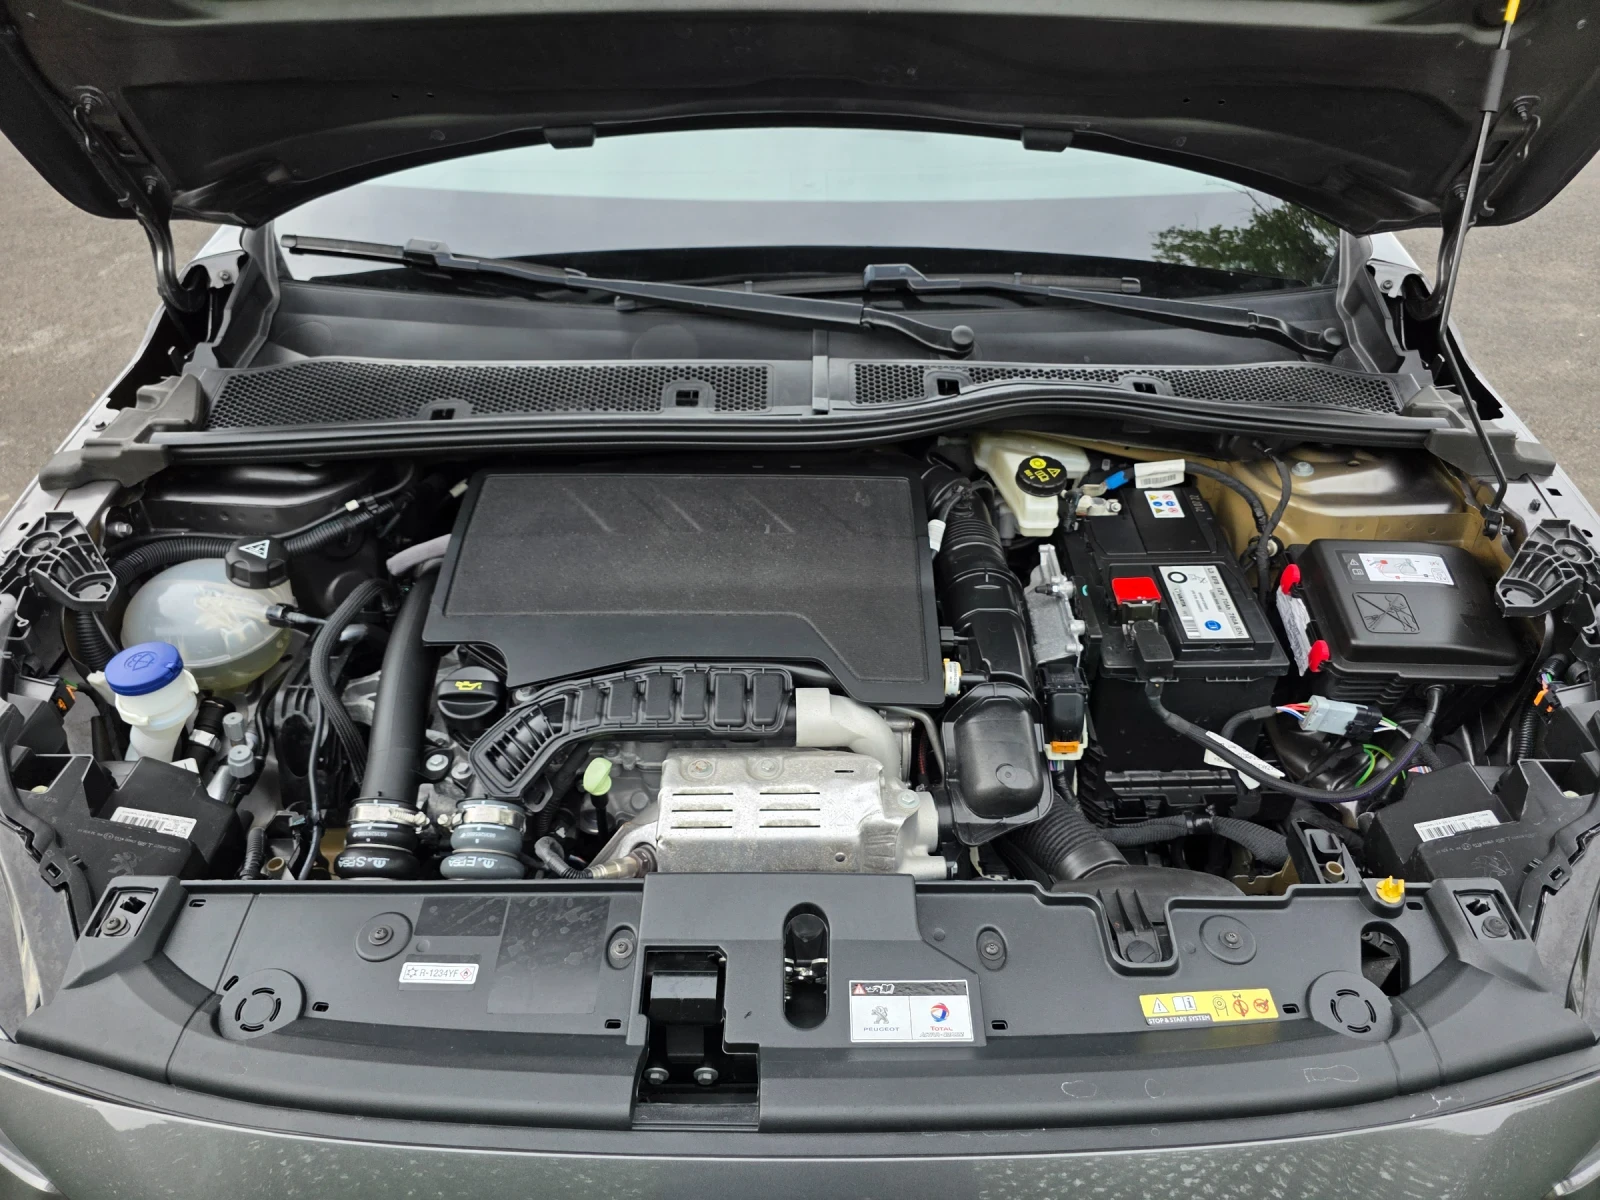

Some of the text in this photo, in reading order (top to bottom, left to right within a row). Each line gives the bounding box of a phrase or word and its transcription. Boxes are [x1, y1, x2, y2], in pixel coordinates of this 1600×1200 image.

[1216, 587, 1225, 596] 12V
[419, 968, 460, 978] R-1234YF
[1148, 1017, 1164, 1025] STOP
